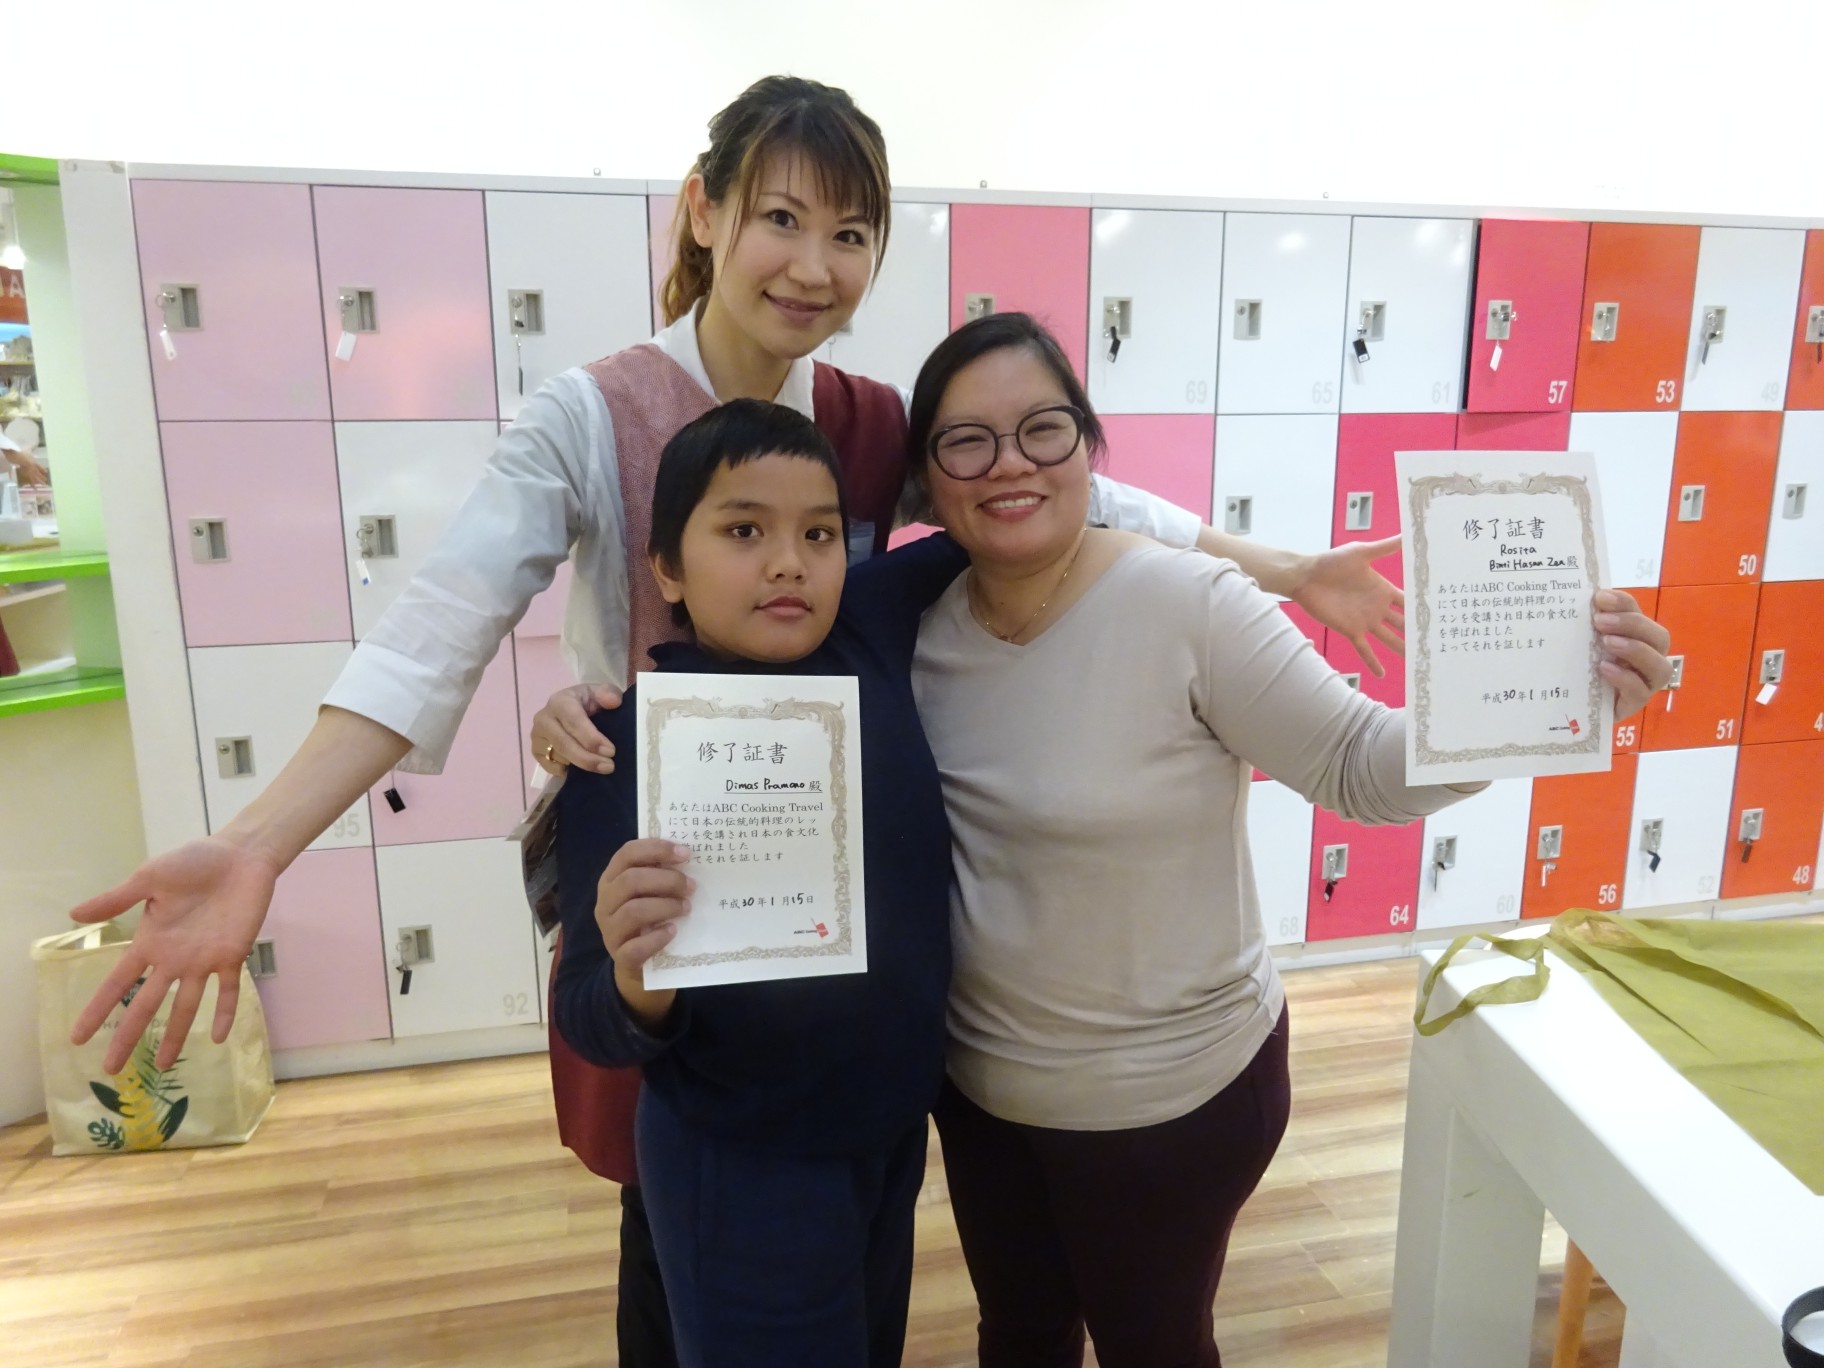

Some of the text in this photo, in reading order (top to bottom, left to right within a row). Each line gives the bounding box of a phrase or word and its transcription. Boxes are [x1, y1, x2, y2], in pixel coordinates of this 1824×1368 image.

[1186, 380, 1208, 405] 69
[1312, 381, 1333, 404] 65
[1431, 381, 1451, 404] 61
[1548, 380, 1568, 405] 57
[1656, 380, 1675, 403] 53
[1761, 381, 1779, 402] 49
[1463, 516, 1546, 541] 修了証書
[1500, 544, 1537, 556] Rosita
[1636, 559, 1655, 579] 54
[1738, 554, 1757, 576] 50
[1506, 581, 1548, 592] Cooking
[1550, 579, 1582, 590] Travel
[1440, 625, 1513, 639] を学ばれました
[1616, 726, 1635, 747] 55
[1716, 719, 1735, 740] 51
[697, 741, 788, 765] 修了証書
[726, 779, 758, 791] Dimas
[741, 803, 786, 814] Cooking
[789, 802, 823, 812] Travel
[333, 812, 360, 837] 95
[1697, 875, 1715, 896] 52
[1792, 865, 1810, 885] 48
[1496, 895, 1516, 915] 60
[1598, 884, 1617, 905] 56
[1279, 916, 1299, 937] 68
[1389, 905, 1410, 927] 64
[503, 993, 530, 1017] 92
